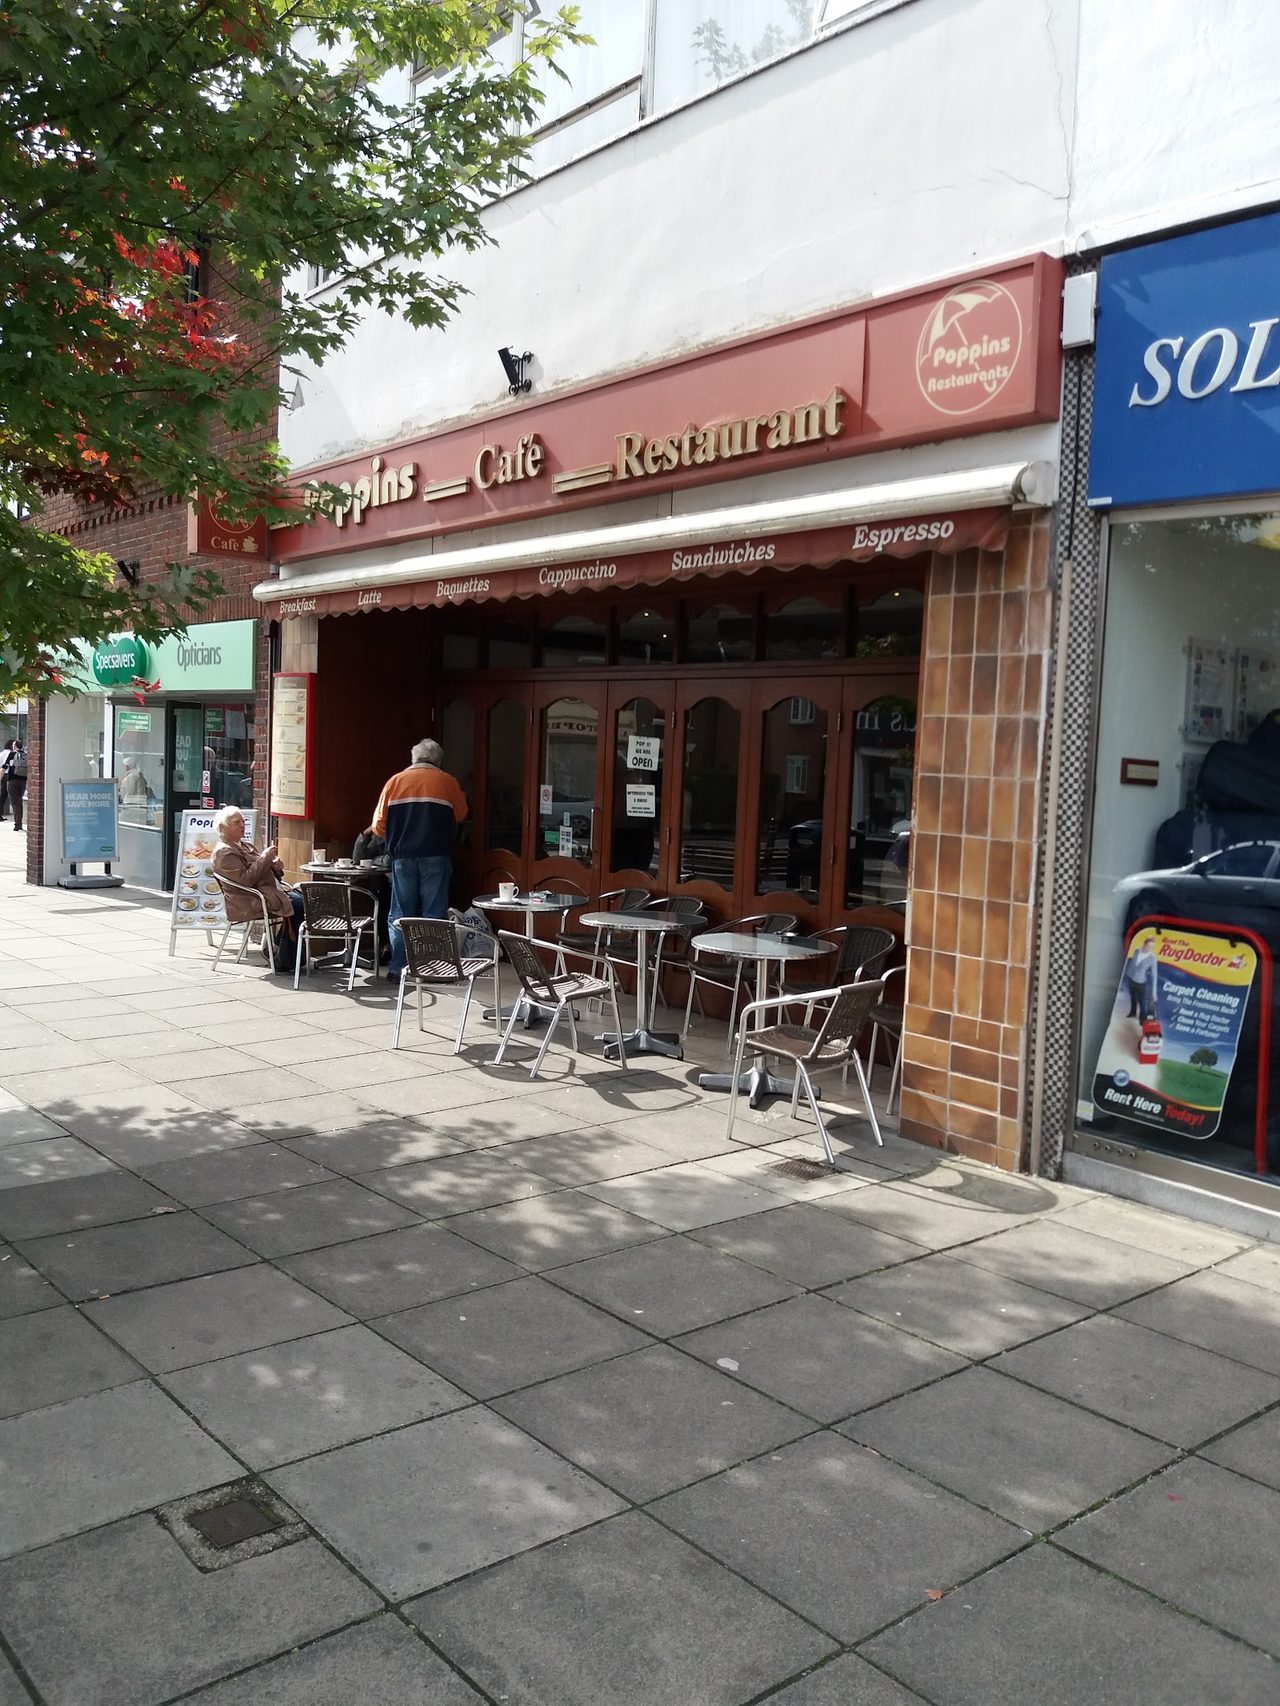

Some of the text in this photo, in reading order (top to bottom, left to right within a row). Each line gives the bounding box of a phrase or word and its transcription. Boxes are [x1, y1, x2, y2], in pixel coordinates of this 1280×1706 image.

[933, 335, 1011, 368] Poppins
[928, 365, 1009, 393] Restaurants
[474, 432, 545, 490] Café
[614, 384, 846, 481] Restaurant
[852, 519, 955, 551] Espresso
[671, 541, 776, 571] Sandwiches
[538, 560, 617, 588] Cappuccino
[358, 589, 382, 606] Latte
[436, 579, 490, 599] Baguettes
[279, 597, 317, 615] Breakfast
[95, 651, 136, 674] Specsavers
[176, 641, 222, 671] Opticians
[631, 756, 653, 768] OPEN
[65, 792, 88, 801] HEAR
[65, 800, 110, 808] SAVE MORE
[1163, 981, 1240, 1008] Carpet Cleaning
[1104, 1088, 1133, 1106] Rent
[1133, 1096, 1162, 1114] Here
[1163, 1104, 1206, 1126] Today!
